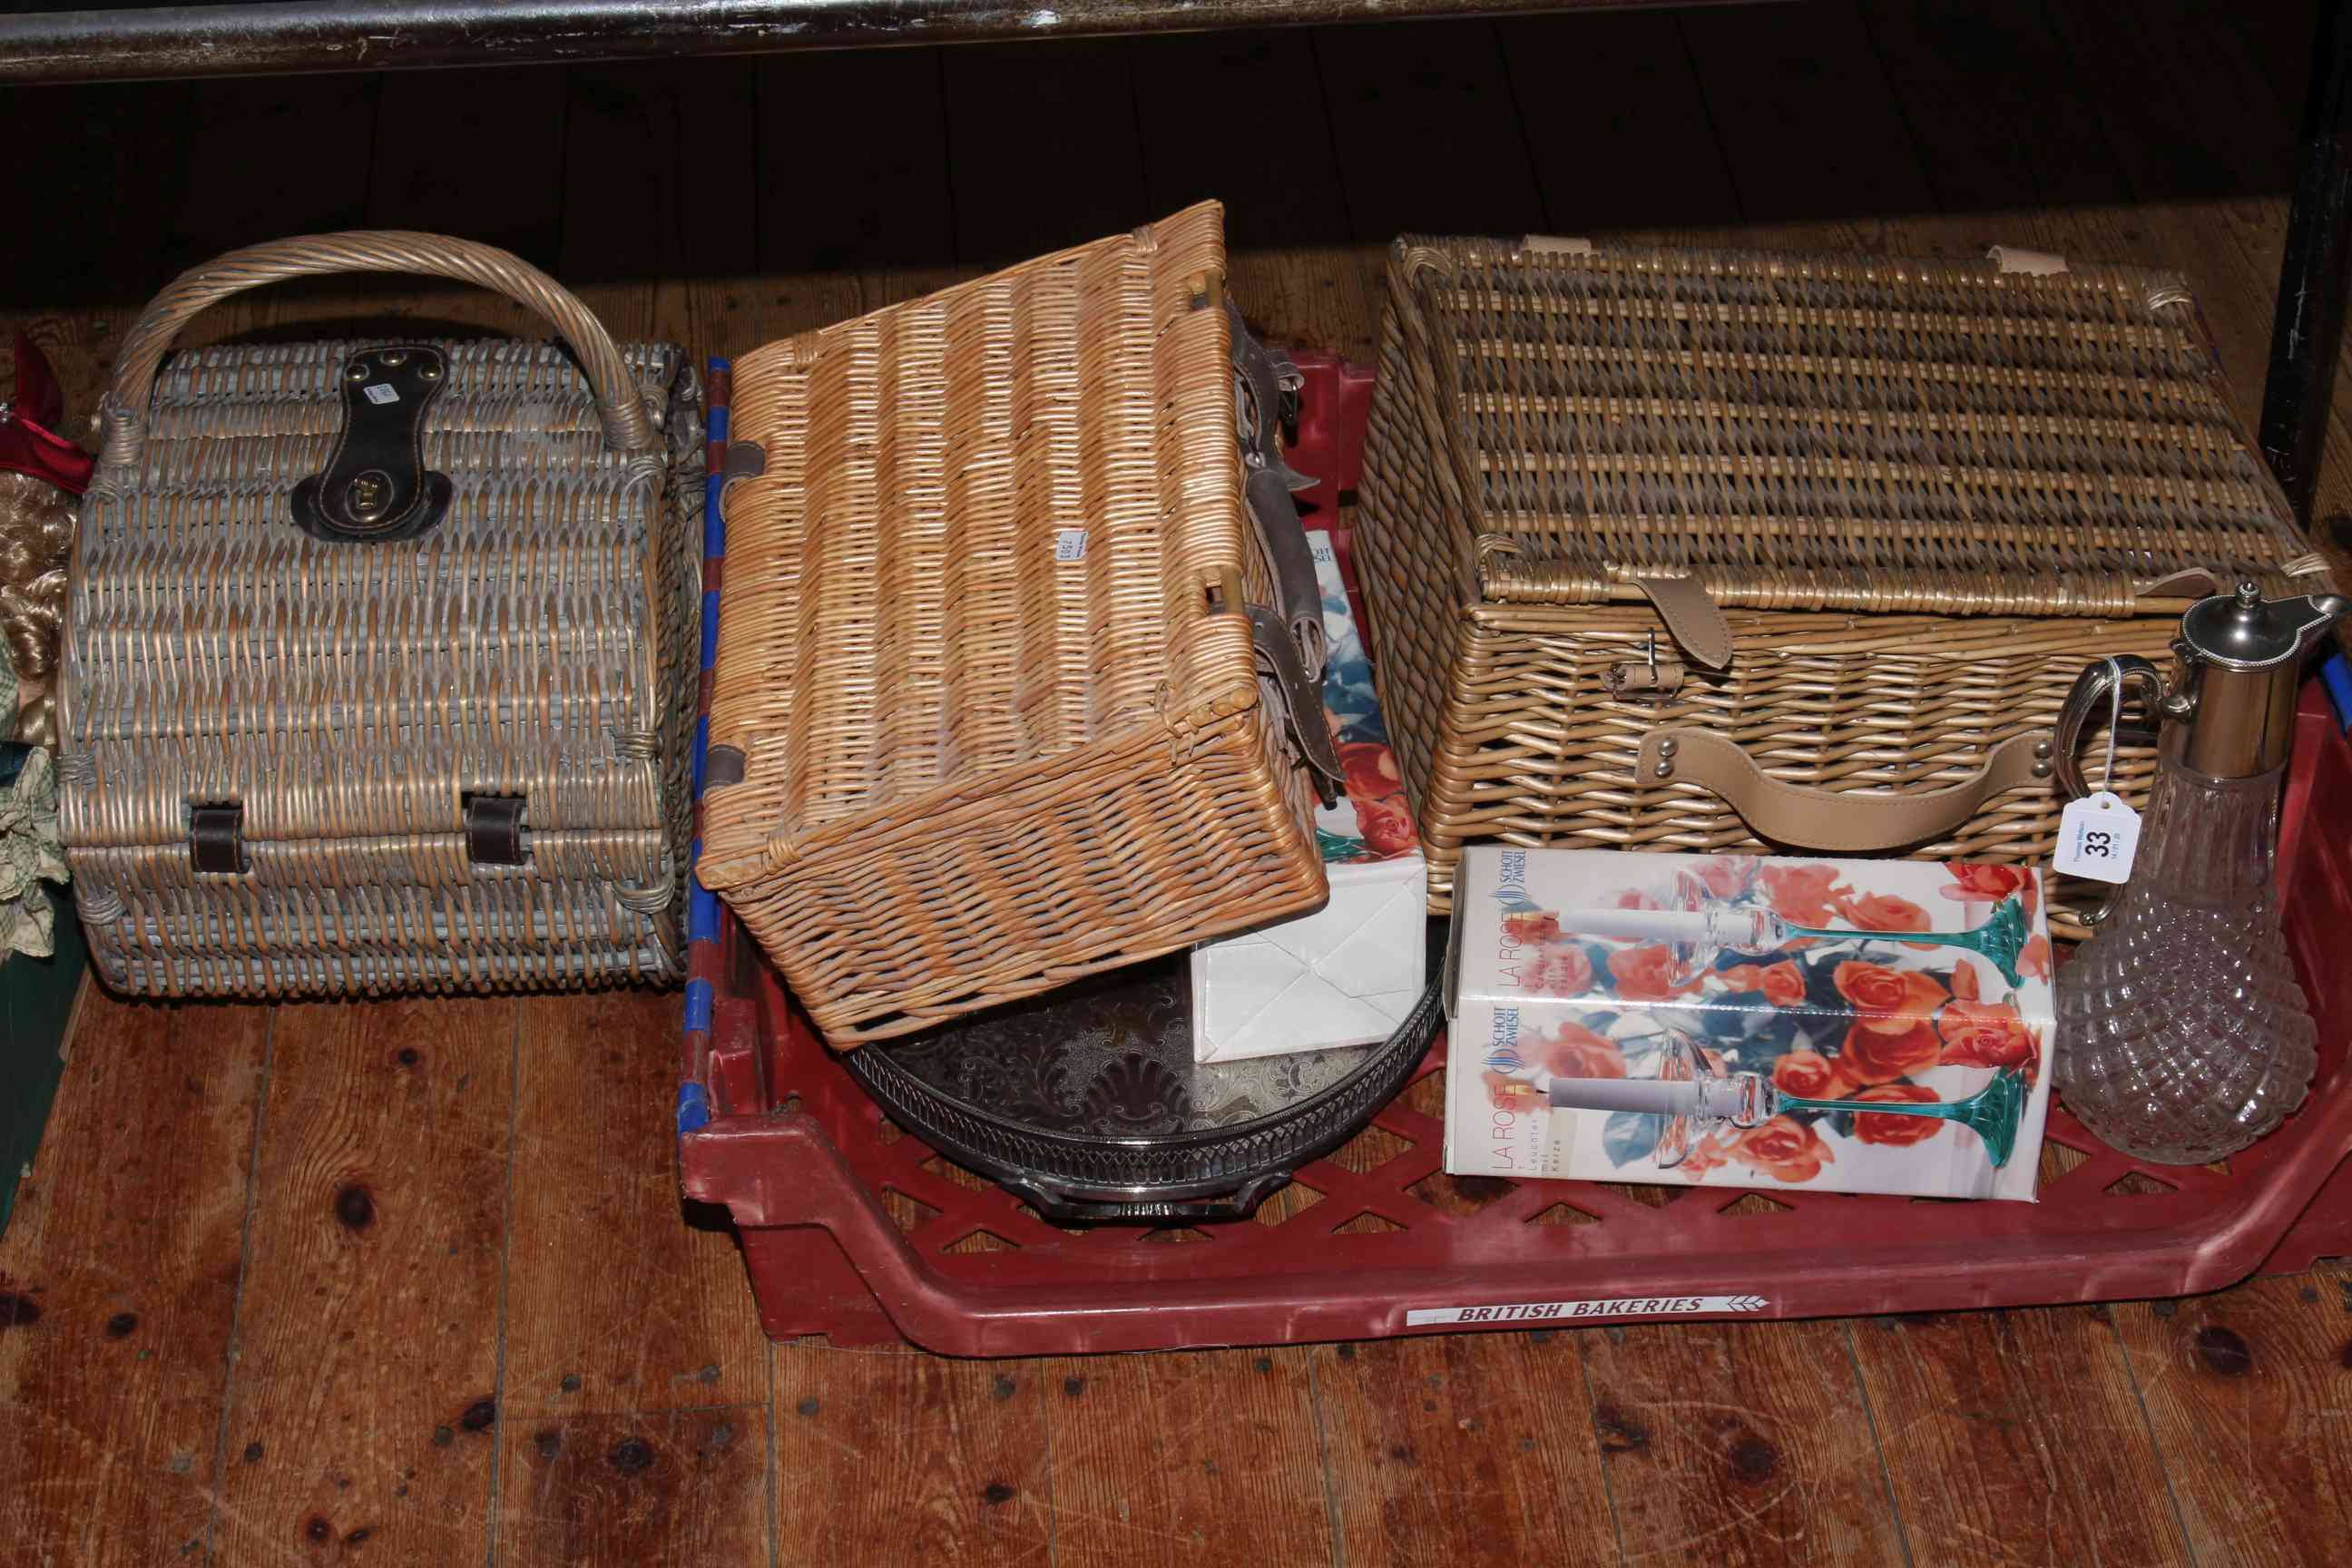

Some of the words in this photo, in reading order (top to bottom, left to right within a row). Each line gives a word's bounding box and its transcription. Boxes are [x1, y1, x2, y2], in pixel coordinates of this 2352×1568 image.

[2084, 831, 2111, 858] 33
[1500, 850, 1513, 883] SCHOTT
[1513, 850, 1526, 883] ZWIESEL
[1499, 912, 1524, 960] ROSE
[1499, 965, 1521, 987] LA
[1493, 1006, 1505, 1047] SCHOTT
[1505, 1006, 1519, 1047] ZWIESEL
[1493, 1084, 1516, 1140] ROSE
[1493, 1146, 1514, 1170] LA
[1457, 1304, 1563, 1321] BRITISH
[1573, 1298, 1703, 1316] BAKERIES
